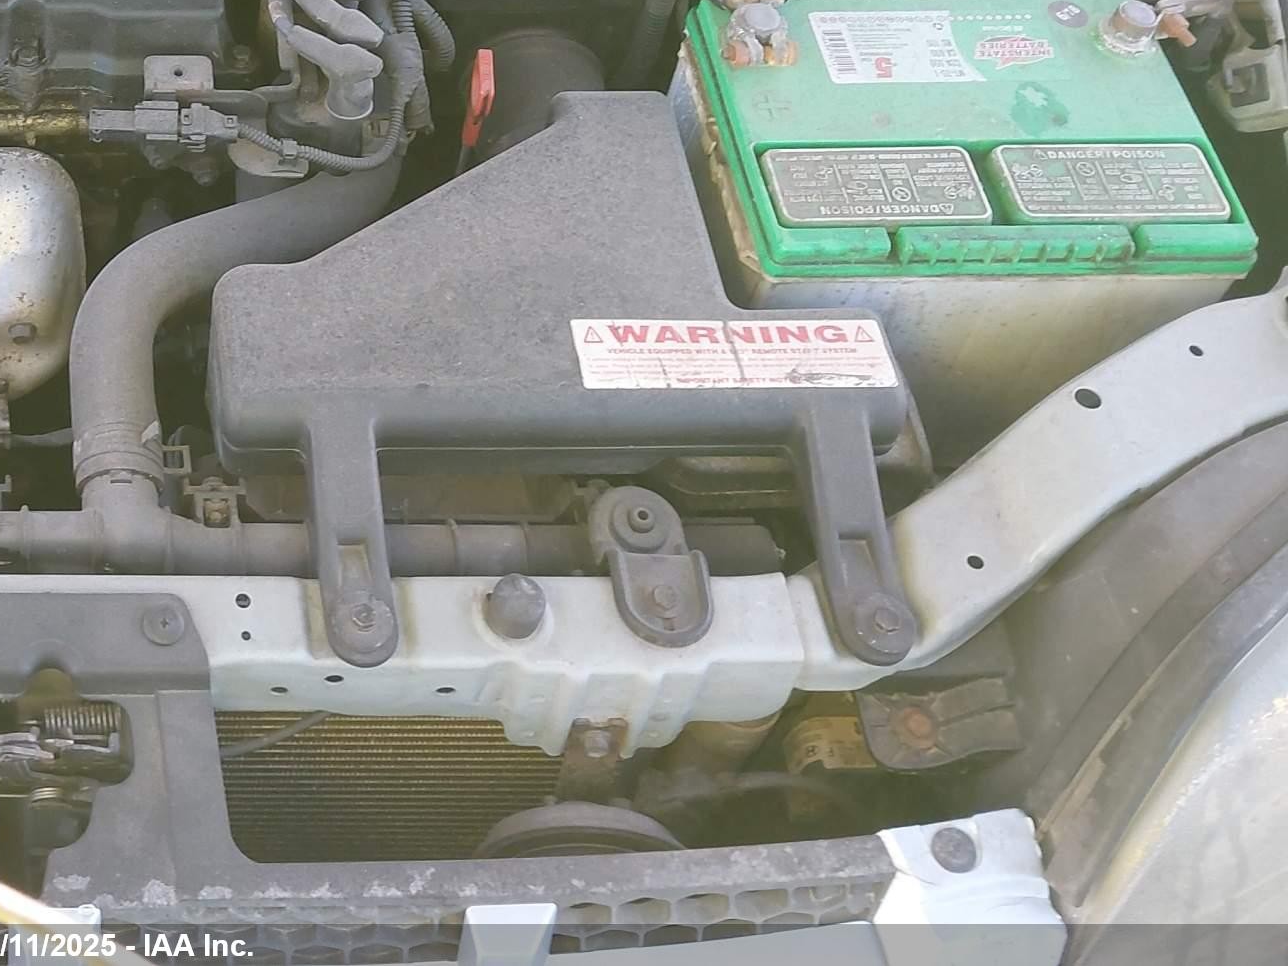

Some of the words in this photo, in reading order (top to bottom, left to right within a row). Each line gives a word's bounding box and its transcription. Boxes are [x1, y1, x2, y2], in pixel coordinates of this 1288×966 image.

[977, 49, 1052, 58] INTERSTATE
[875, 56, 893, 79] 5
[820, 203, 939, 215] DANGER/POISON
[606, 325, 850, 344] WARNING
